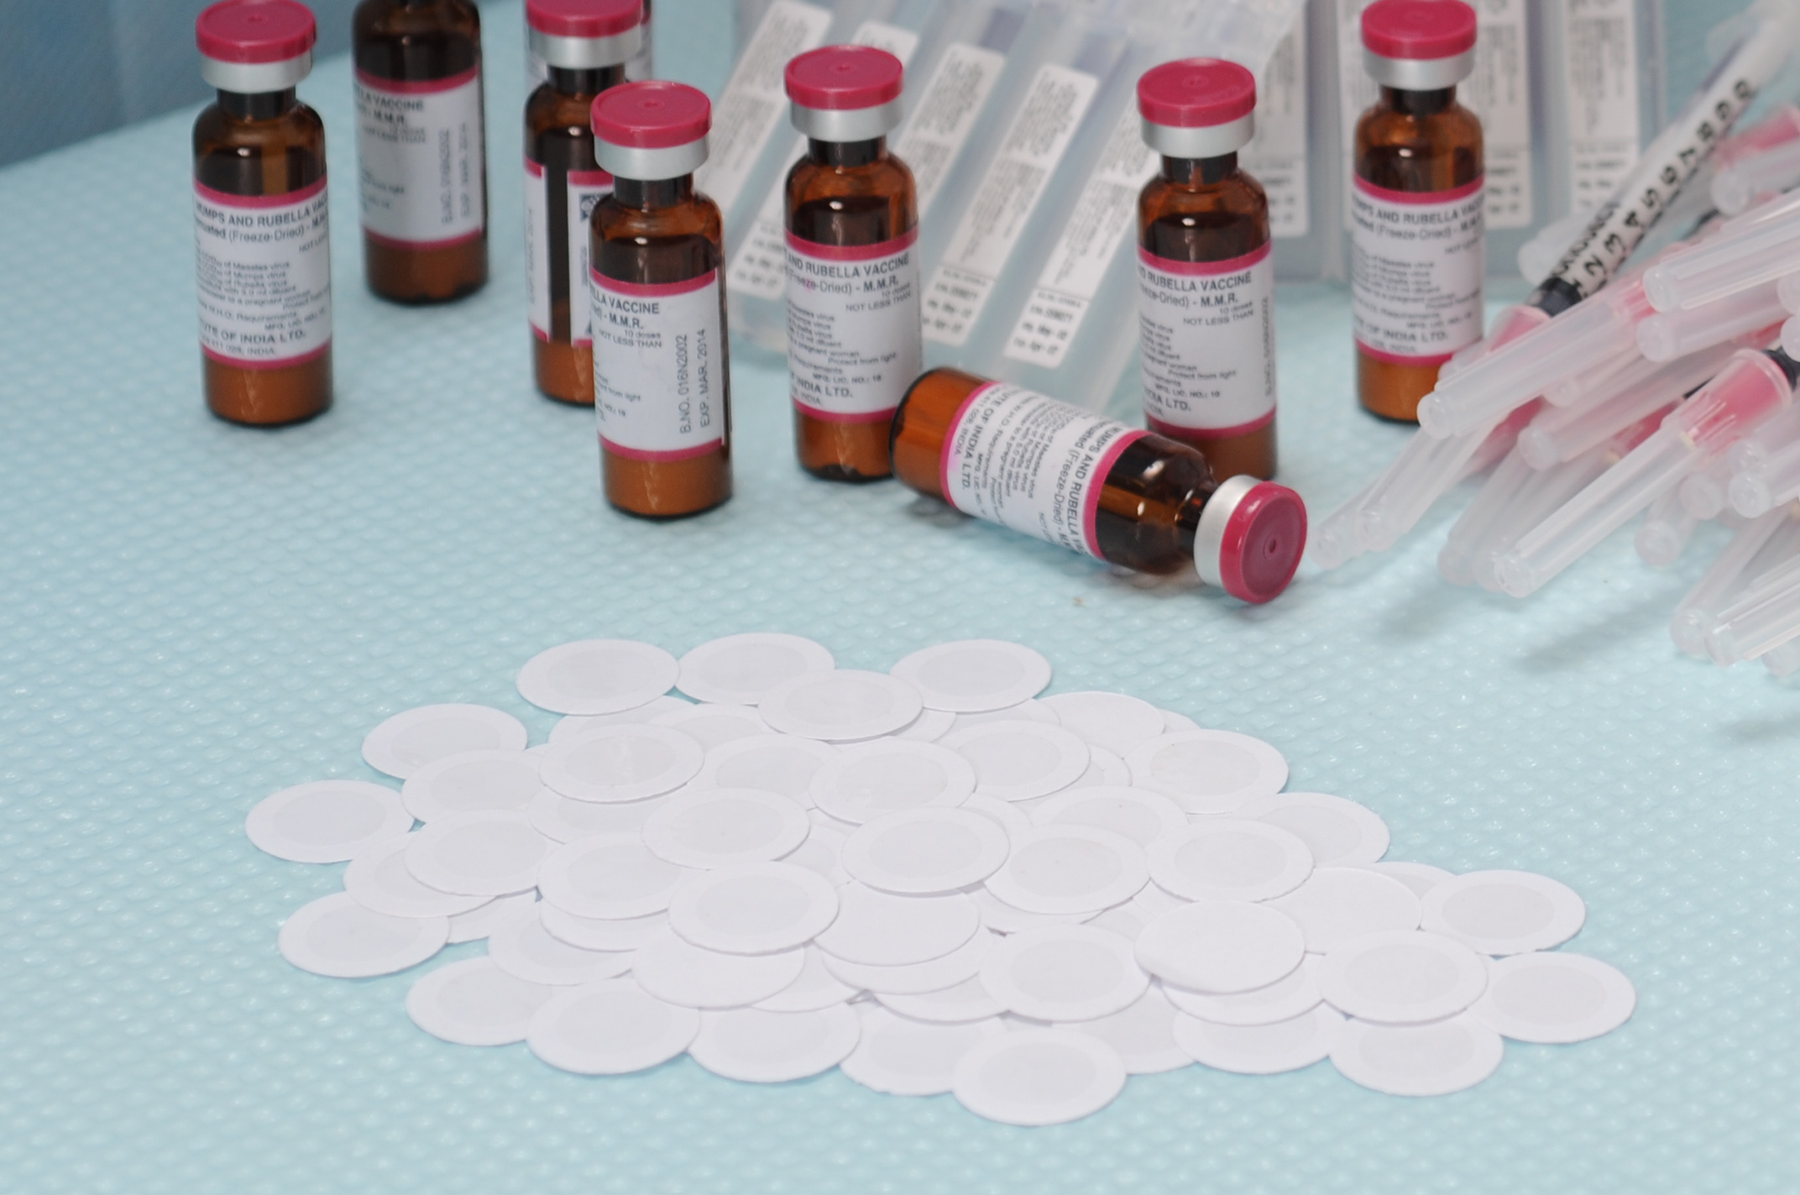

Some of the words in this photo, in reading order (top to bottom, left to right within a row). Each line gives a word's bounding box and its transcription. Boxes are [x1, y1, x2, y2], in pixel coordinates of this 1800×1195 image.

[228, 215, 254, 228] AND
[257, 205, 311, 228] RUBELLA
[805, 260, 860, 279] RUBELLA
[863, 252, 910, 277] VACCINE
[863, 275, 900, 293] M.M.R.
[1148, 272, 1197, 293] RUBELLA
[1200, 271, 1252, 292] VACCINE
[609, 297, 660, 315] VACCINE
[845, 303, 866, 312] NOT
[1200, 292, 1238, 308] M.M.R.
[609, 312, 644, 330] M.M.R.
[1183, 317, 1202, 326] NOT
[1205, 315, 1230, 326] LESS
[240, 333, 276, 345] INDIA
[637, 339, 662, 349] THAN
[825, 385, 854, 398] LTD.
[1165, 398, 1192, 412] LTD.
[963, 424, 984, 460] INDIA
[1075, 454, 1096, 480] AND
[961, 463, 971, 490] LTD.
[1066, 481, 1084, 536] RUBELLA
